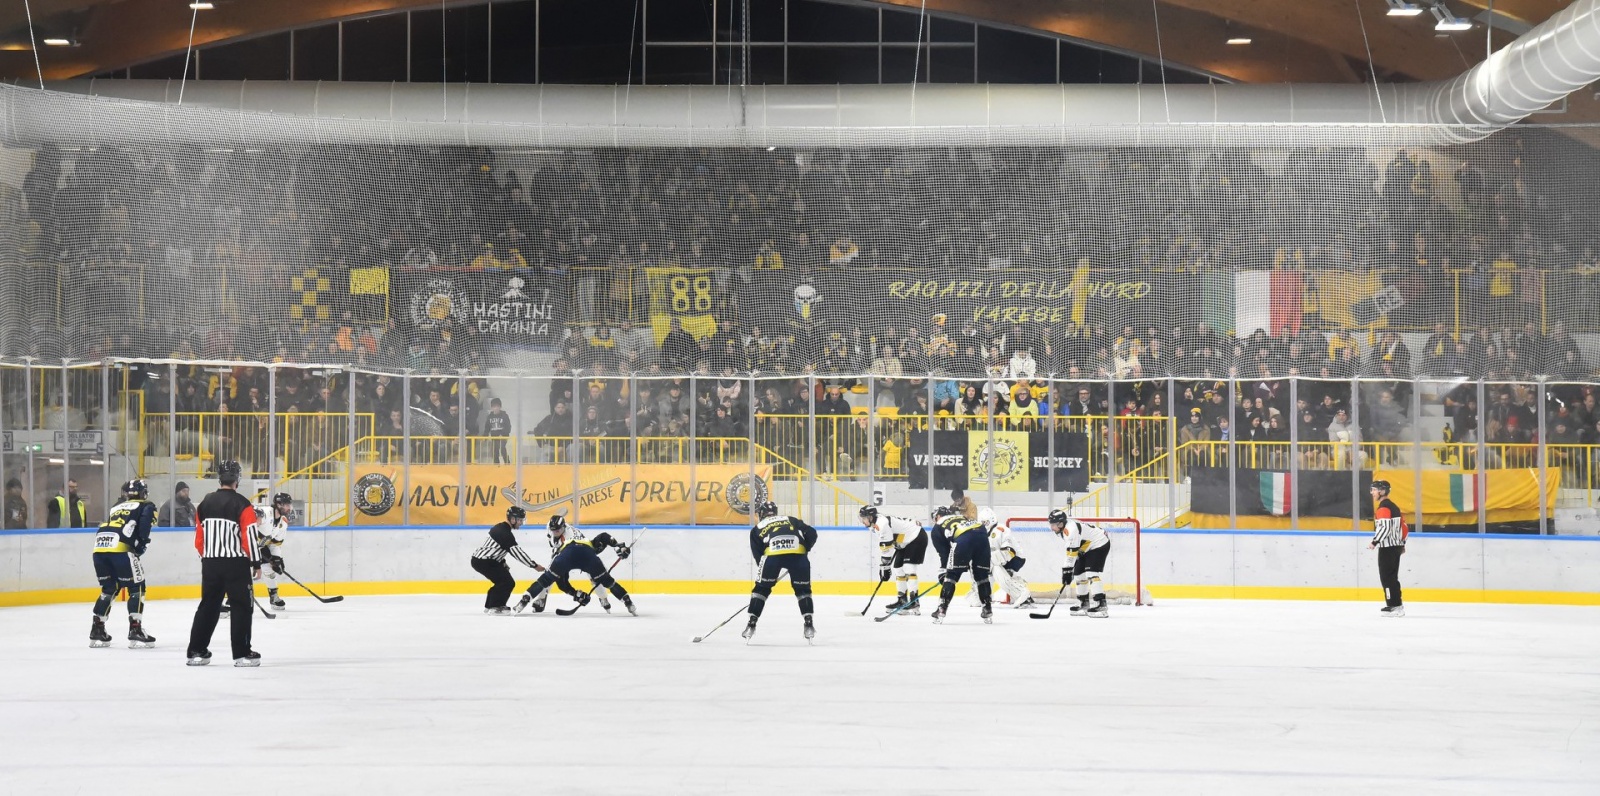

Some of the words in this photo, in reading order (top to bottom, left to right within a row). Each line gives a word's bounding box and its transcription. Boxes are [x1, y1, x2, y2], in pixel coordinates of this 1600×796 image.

[670, 276, 712, 312] 88
[888, 280, 993, 300] RAGAZZI
[999, 280, 1074, 300] DELLA
[1086, 281, 1152, 300] NORD
[473, 301, 553, 320] MASTINI
[972, 304, 1068, 324] VARESE
[478, 319, 549, 335] CATANIA
[913, 454, 964, 467] VARESE
[1033, 456, 1083, 469] HOCKEY
[397, 484, 498, 507] MASTINI
[619, 480, 724, 503] FOREVER
[771, 538, 795, 547] SPORT
